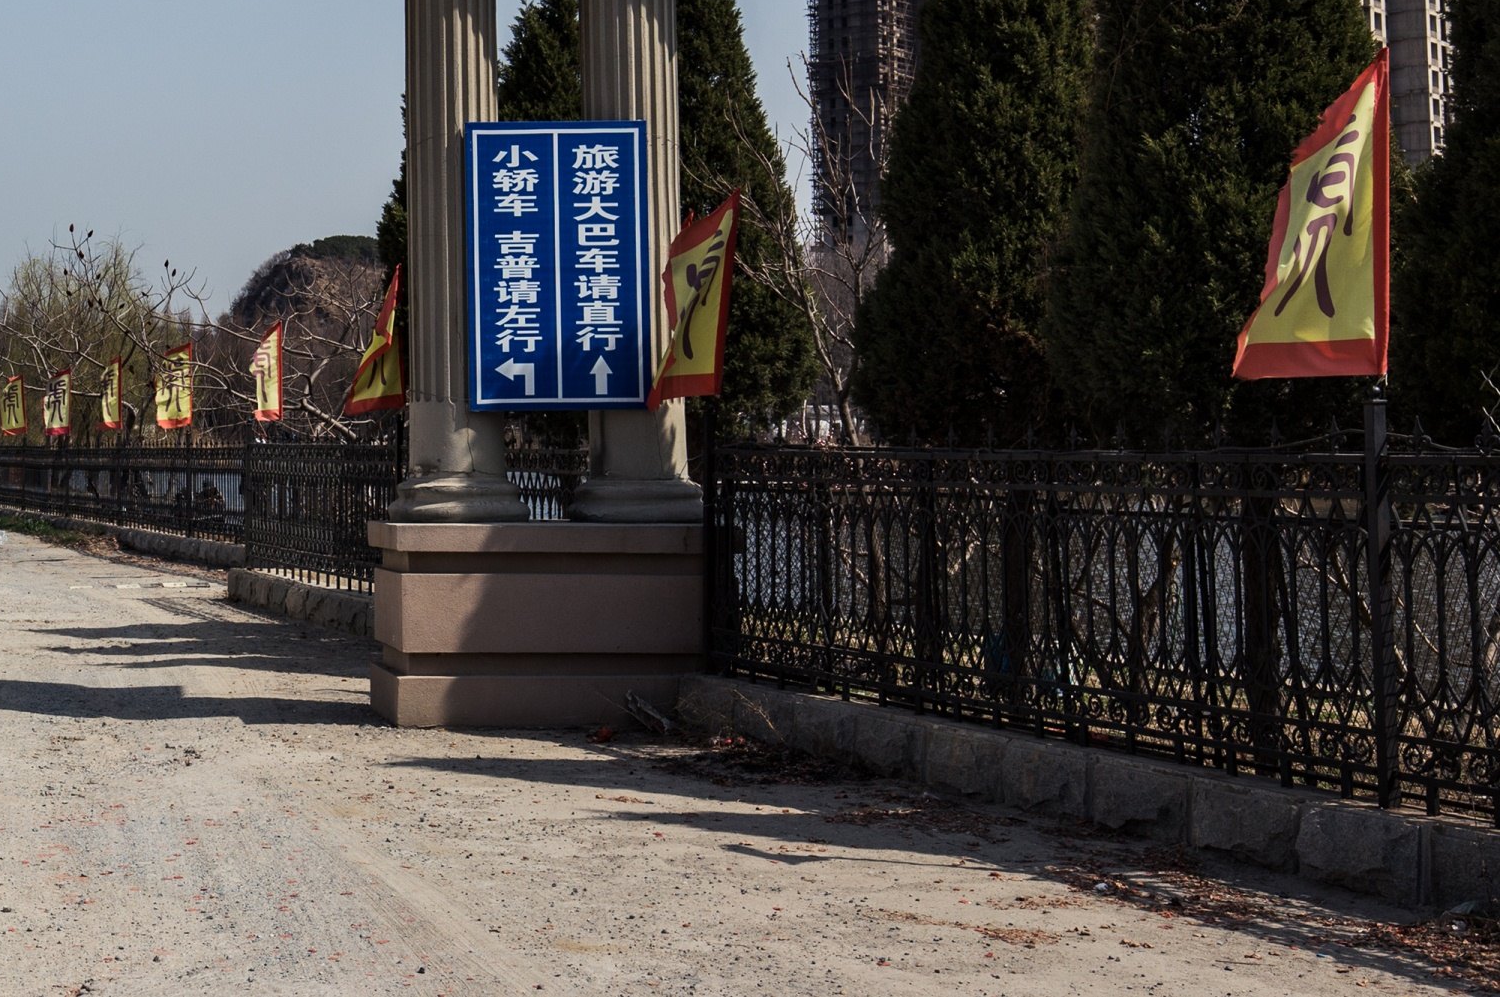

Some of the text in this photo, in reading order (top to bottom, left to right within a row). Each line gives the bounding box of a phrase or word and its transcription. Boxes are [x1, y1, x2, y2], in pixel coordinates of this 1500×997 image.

[492, 144, 543, 353] 小轿车 吉普请左行
[571, 144, 623, 351] 旅游大巴车请直行
